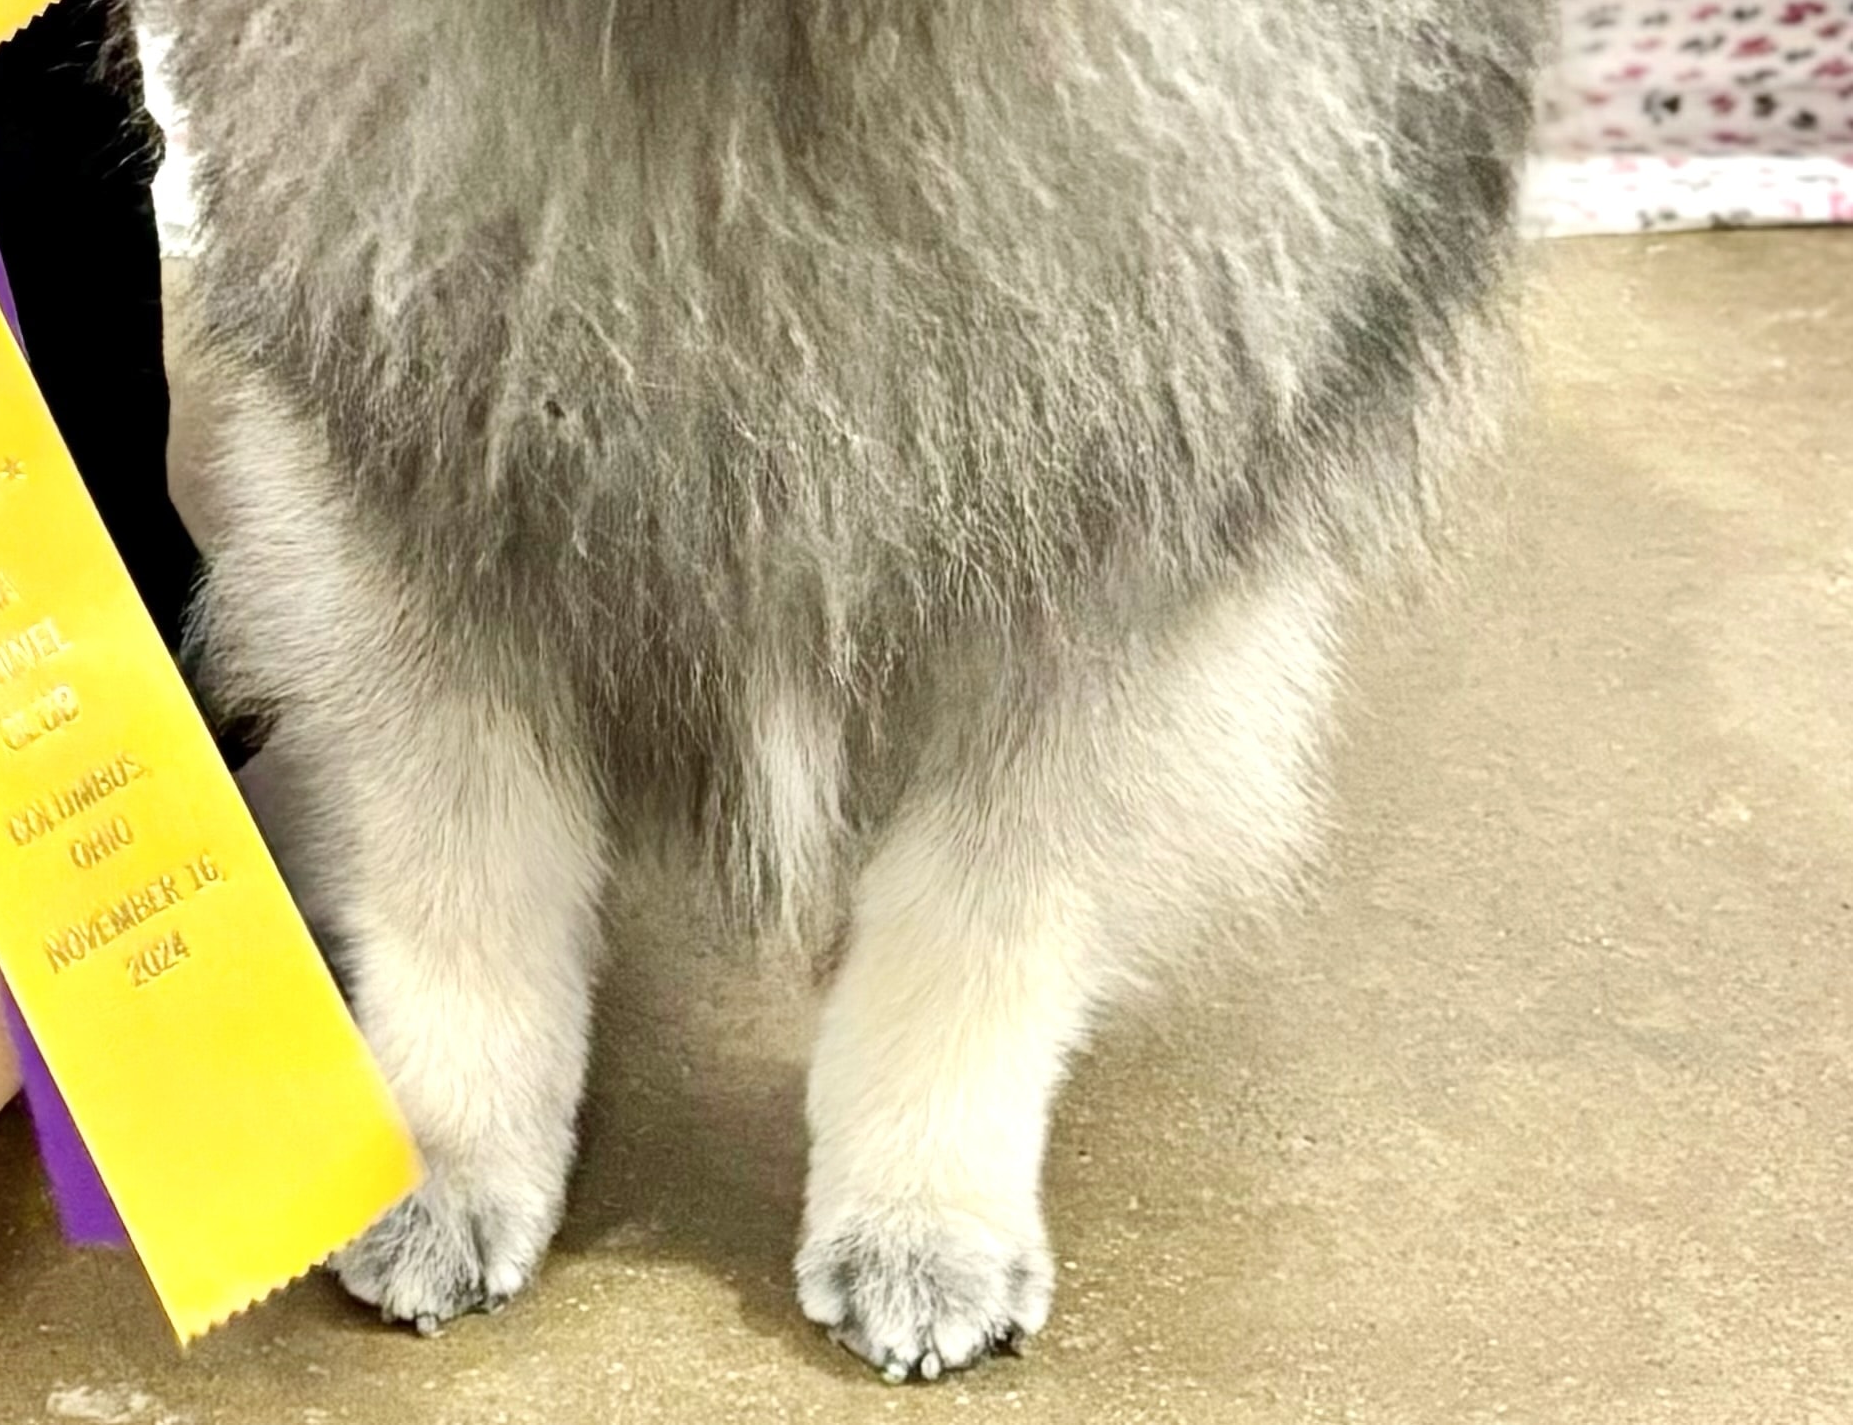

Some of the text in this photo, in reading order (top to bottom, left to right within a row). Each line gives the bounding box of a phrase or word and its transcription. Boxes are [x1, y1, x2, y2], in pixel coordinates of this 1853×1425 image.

[0, 682, 81, 752] CLUB
[68, 813, 136, 870] OHIO
[42, 873, 186, 974] NOVEMBER
[125, 928, 192, 988] 2024
